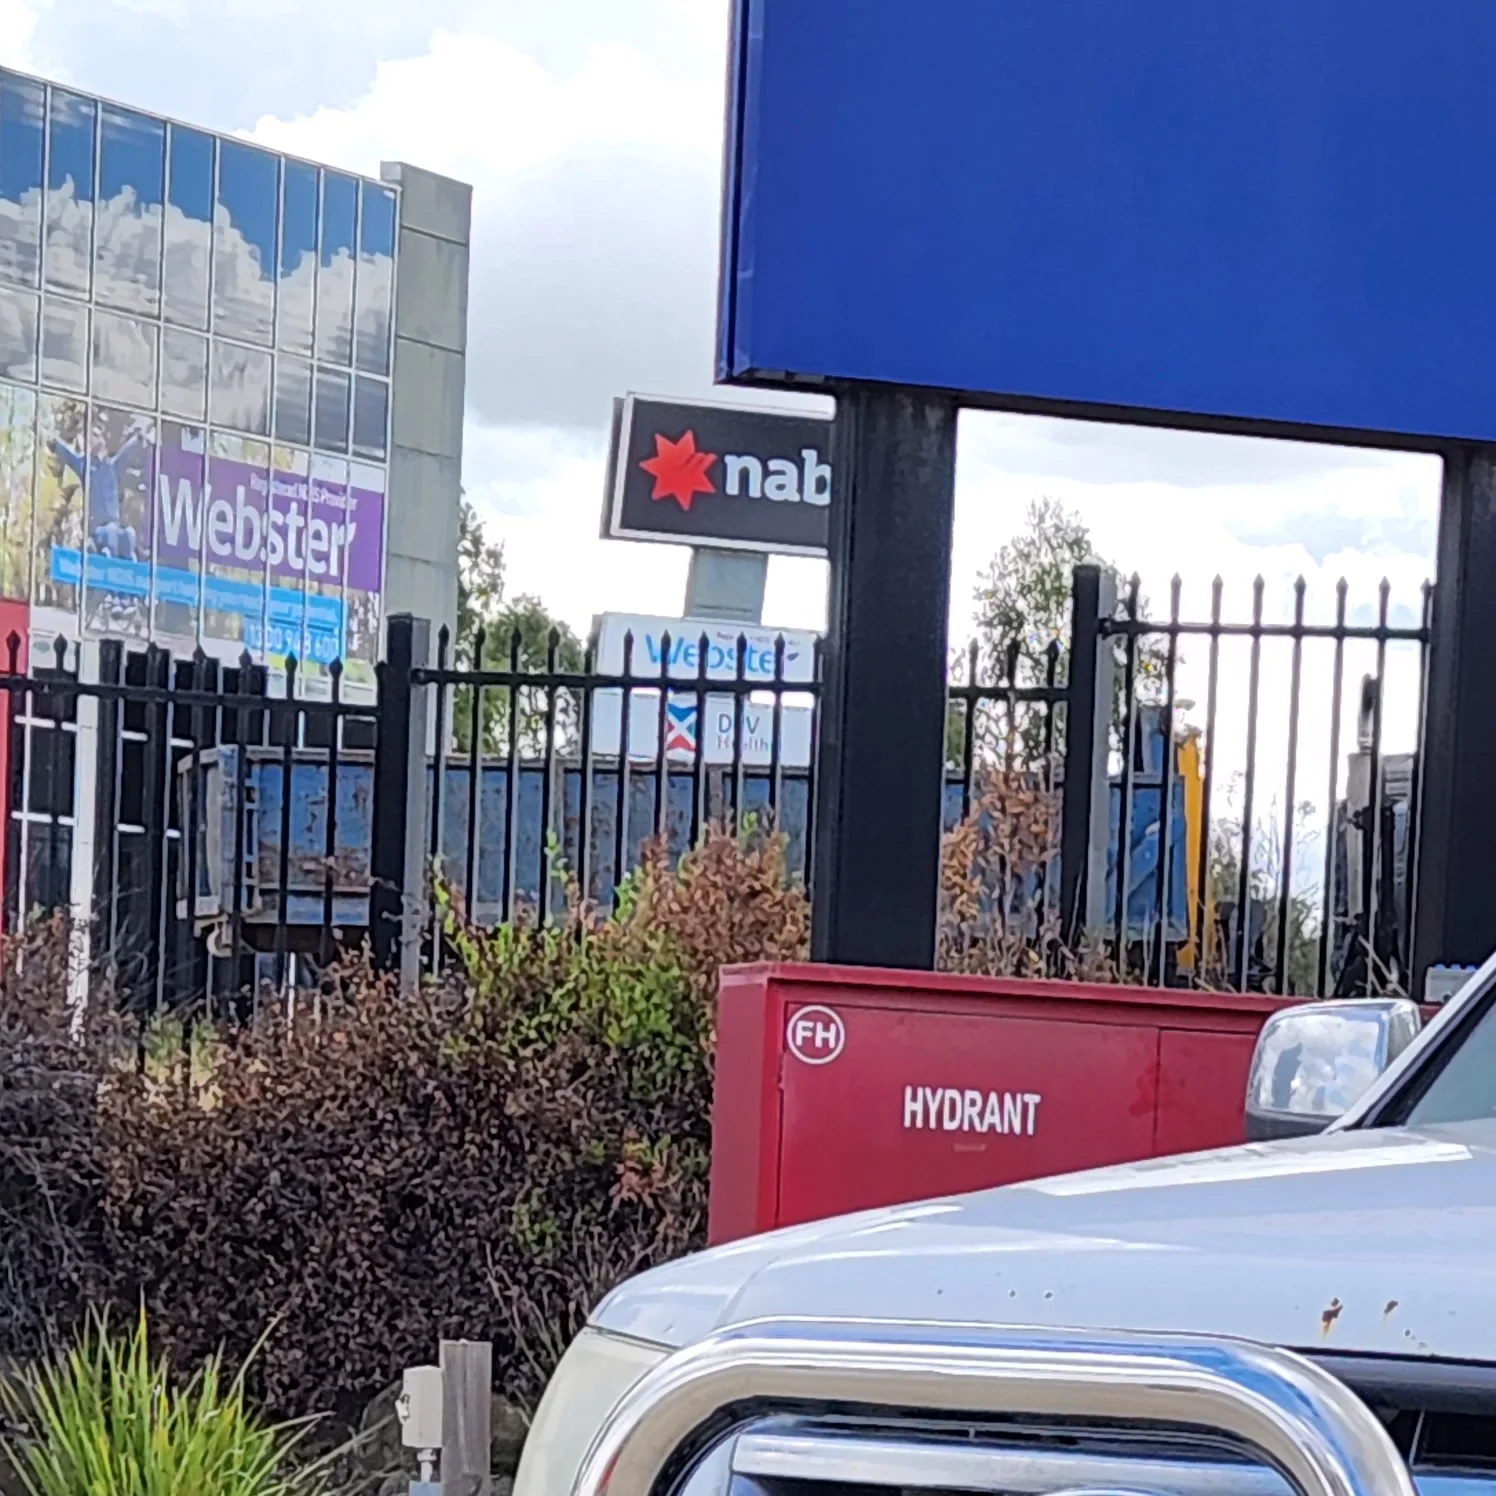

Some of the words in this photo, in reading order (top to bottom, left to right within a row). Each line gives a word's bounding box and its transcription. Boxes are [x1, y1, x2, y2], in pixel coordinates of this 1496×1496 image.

[723, 449, 832, 506] nab
[160, 475, 356, 577] Webster
[718, 714, 760, 735] DV
[794, 1019, 837, 1050] FH
[904, 1085, 1041, 1136] HYDRANT
